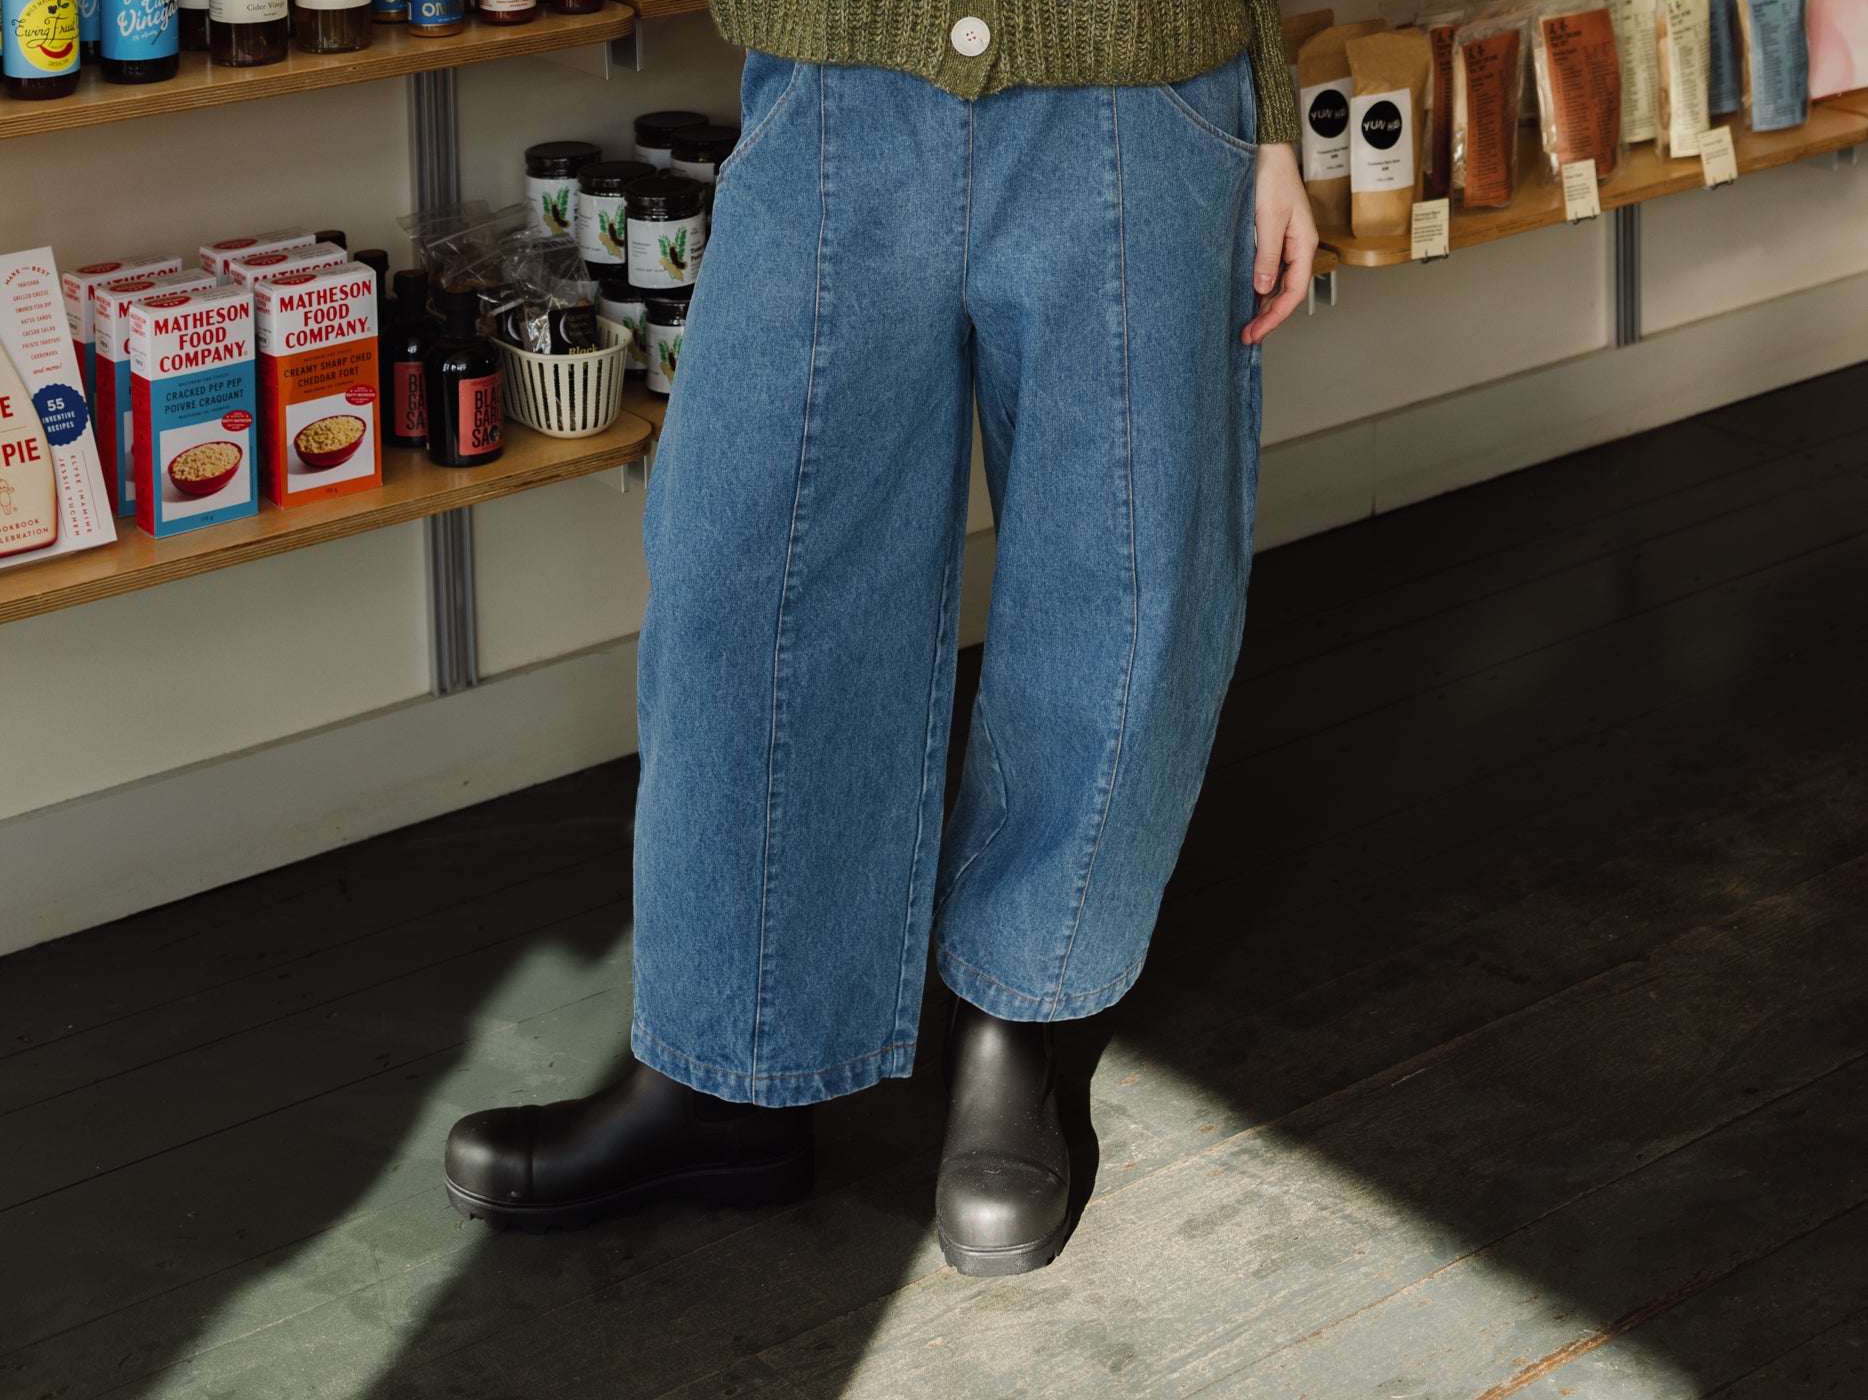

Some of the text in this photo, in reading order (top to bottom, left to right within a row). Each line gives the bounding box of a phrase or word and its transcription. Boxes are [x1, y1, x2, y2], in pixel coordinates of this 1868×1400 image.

[247, 3, 267, 11] Cider
[1363, 120, 1386, 131] YUN
[5, 265, 50, 286] MAKE BEST
[280, 279, 372, 313] MATHESON
[154, 302, 249, 336] MATHESON
[304, 303, 349, 327] FOOD
[179, 327, 227, 351] FOOD
[285, 316, 368, 348] COMPANY
[160, 340, 245, 373] COMPANY
[569, 344, 597, 355] Black
[33, 366, 44, 375] and
[284, 352, 372, 378] CREAMY SHARP CHED
[298, 366, 359, 387] CHEDDAR FORT
[166, 378, 242, 402] CRACKED PEP PEP
[47, 398, 65, 412] 55
[165, 389, 244, 414] POIVRE CRAQUANT
[42, 411, 76, 423] INVENTIVE
[47, 421, 75, 432] RECIPES
